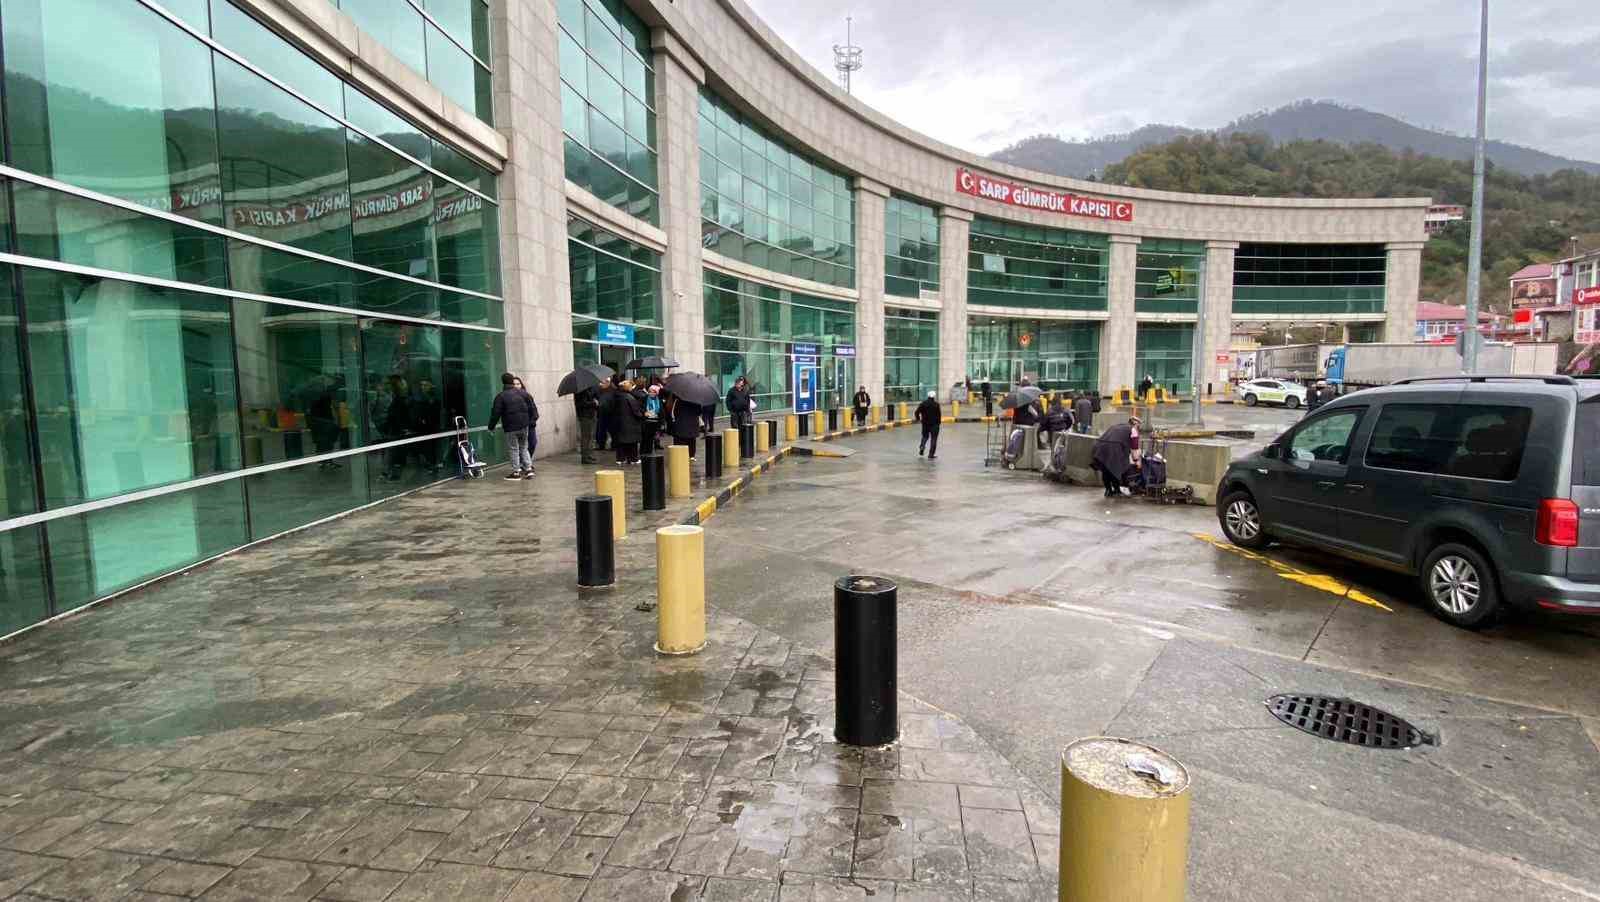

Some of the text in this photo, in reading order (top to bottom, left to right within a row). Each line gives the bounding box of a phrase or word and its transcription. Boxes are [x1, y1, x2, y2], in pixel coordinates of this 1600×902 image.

[979, 179, 1111, 218] SARP GÜMRÜK KAPISI
